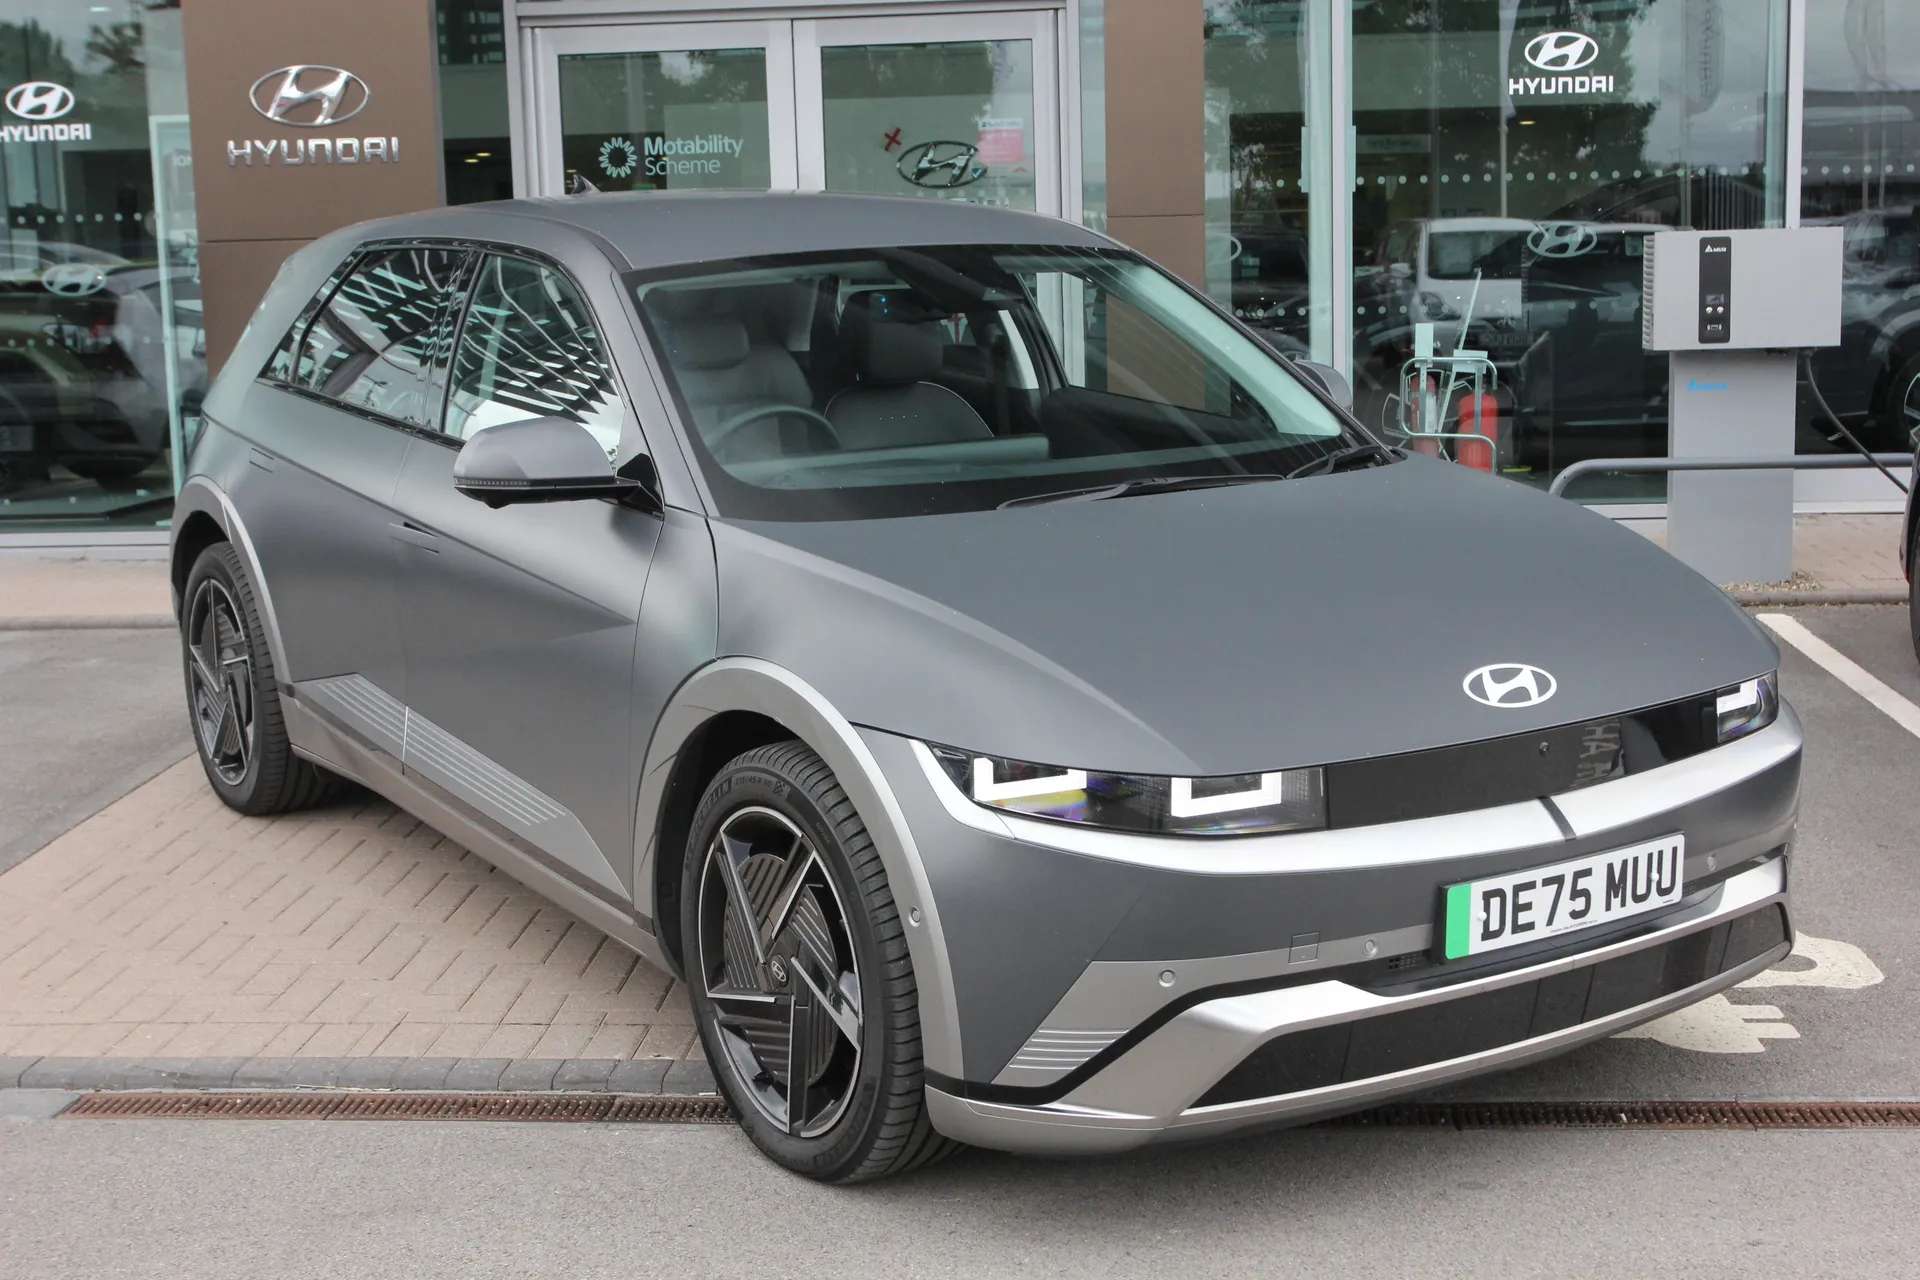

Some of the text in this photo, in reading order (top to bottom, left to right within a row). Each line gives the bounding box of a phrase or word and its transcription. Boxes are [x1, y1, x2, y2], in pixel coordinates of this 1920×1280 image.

[1508, 75, 1614, 95] HYUNDAI
[0, 124, 92, 142] HYUNDAI
[227, 137, 400, 166] HYUNDAI
[644, 134, 744, 157] Motability
[645, 157, 721, 176] Scheme
[1481, 846, 1678, 942] DE75 MUU
